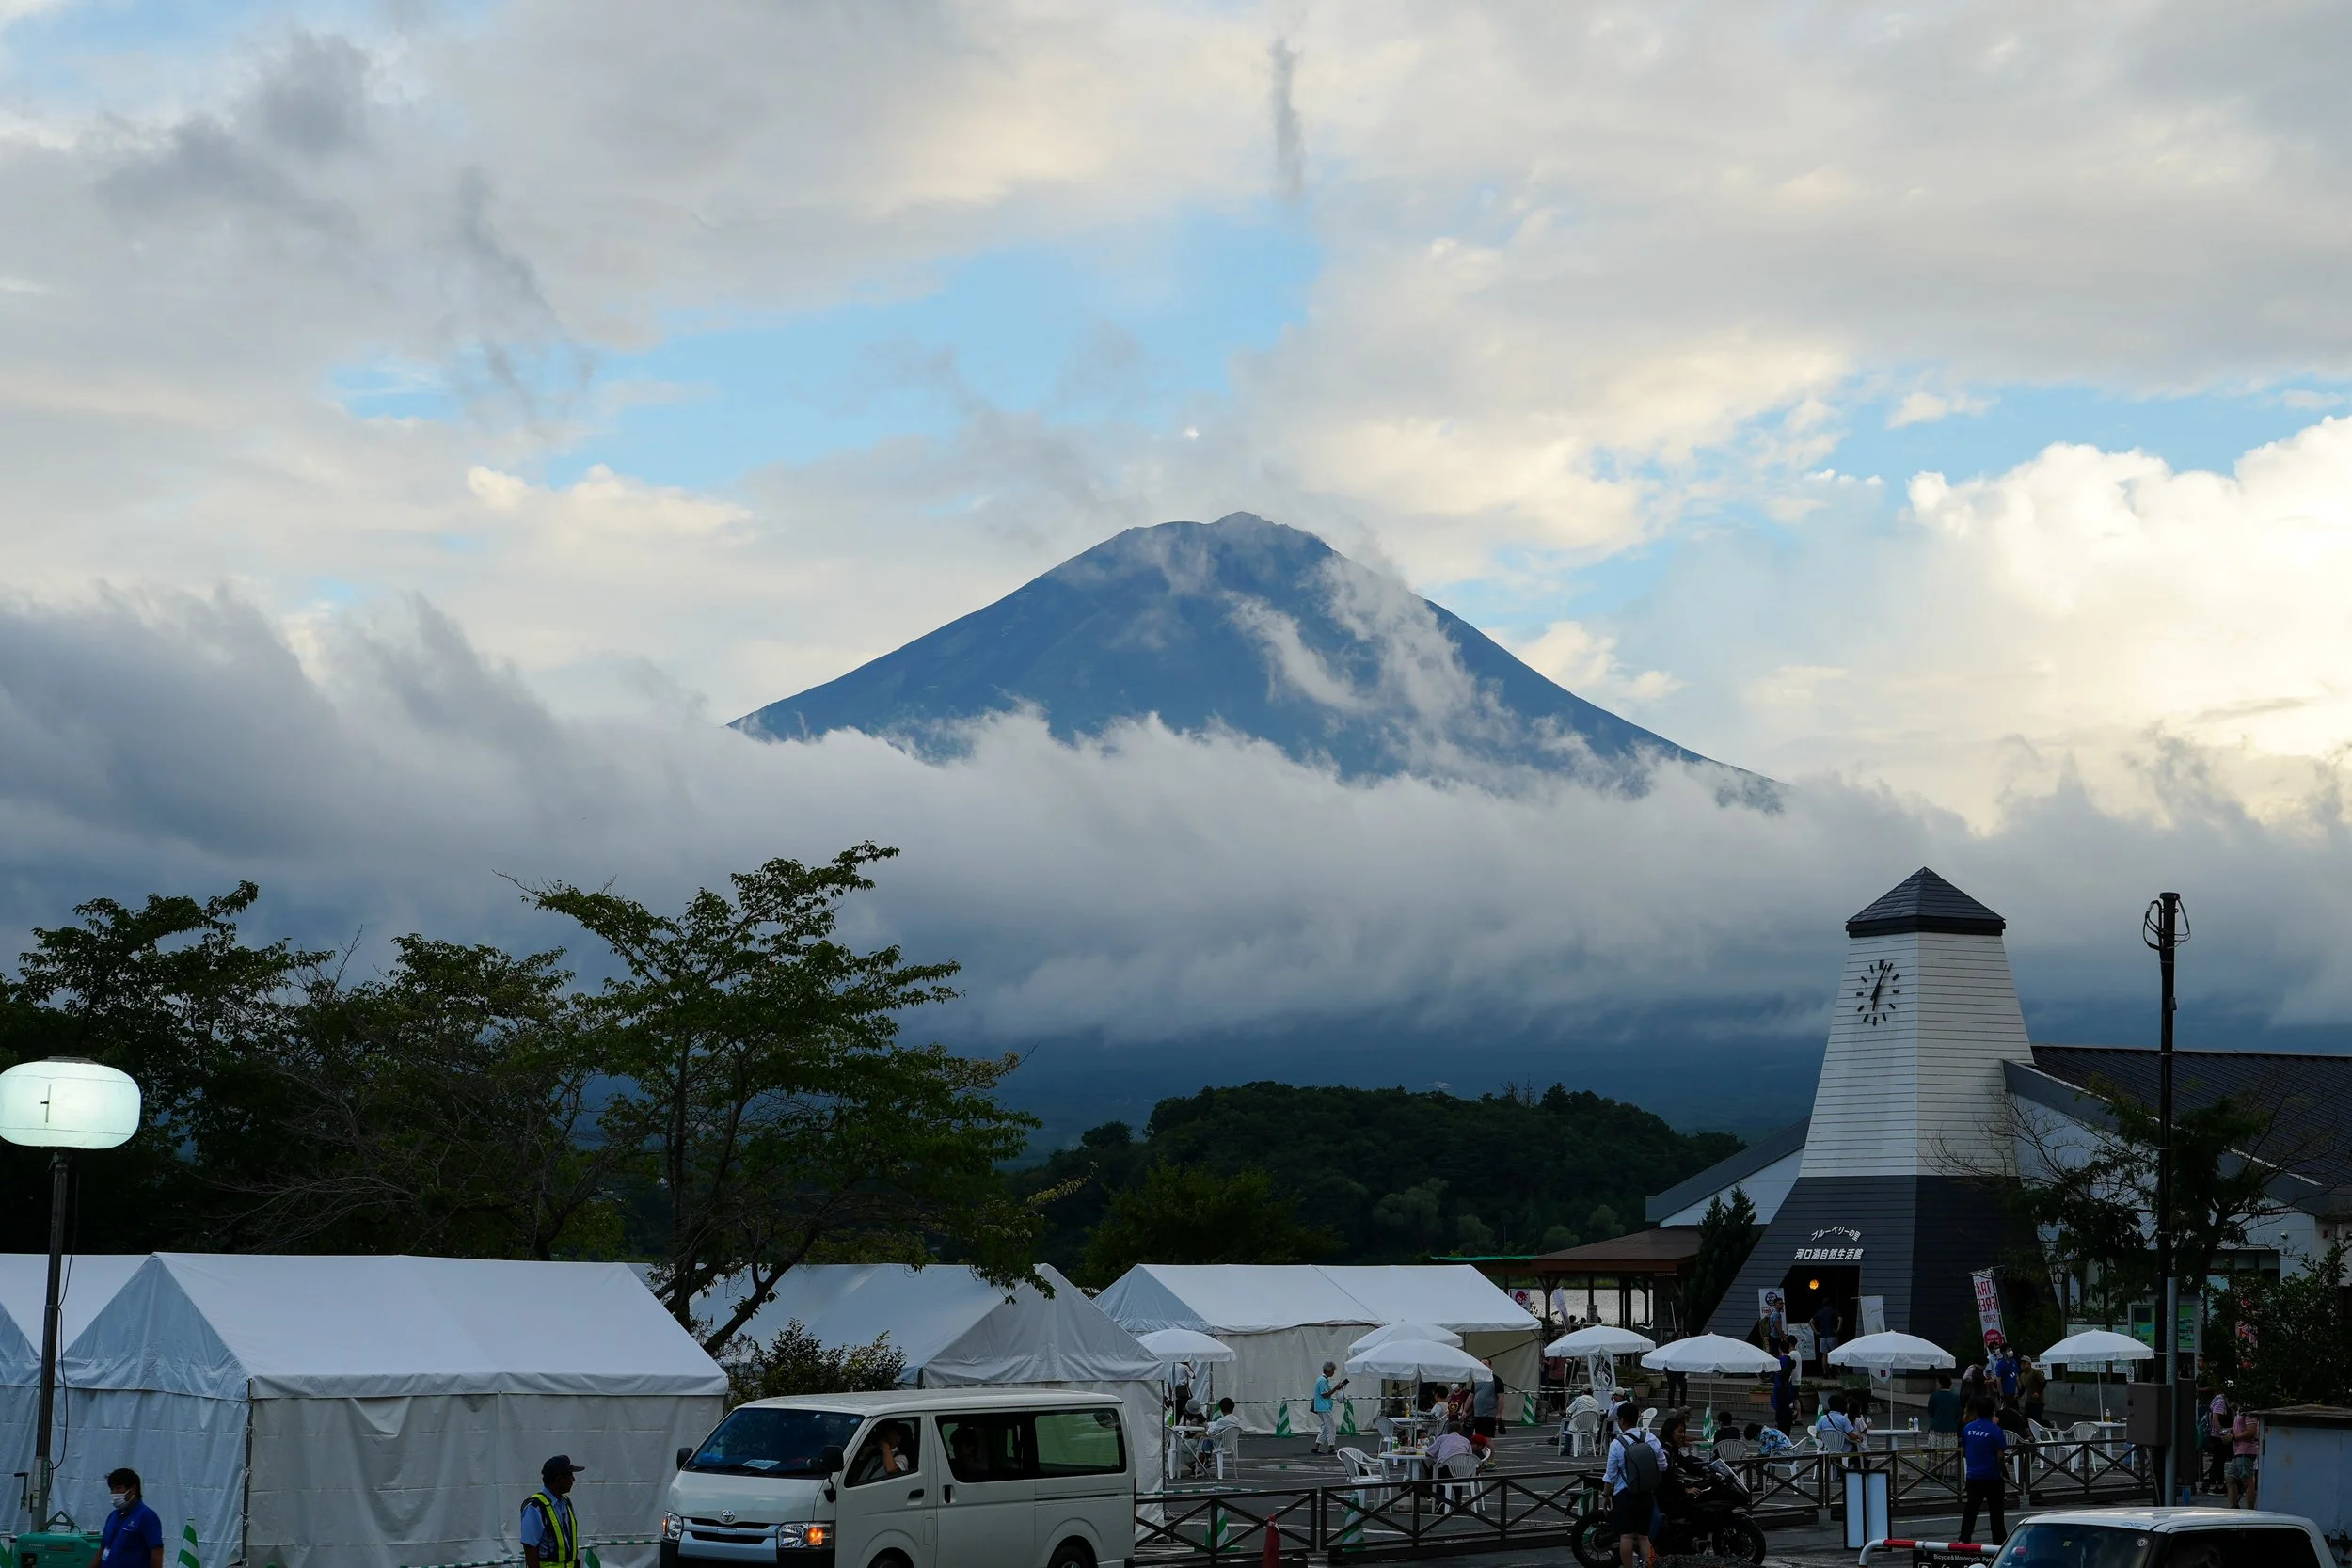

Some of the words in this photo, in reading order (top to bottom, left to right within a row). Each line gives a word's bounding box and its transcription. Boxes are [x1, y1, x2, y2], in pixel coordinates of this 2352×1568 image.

[1811, 1226, 1862, 1242] ブルーベリーの里
[1793, 1248, 1864, 1260] 河口湖自然生活館
